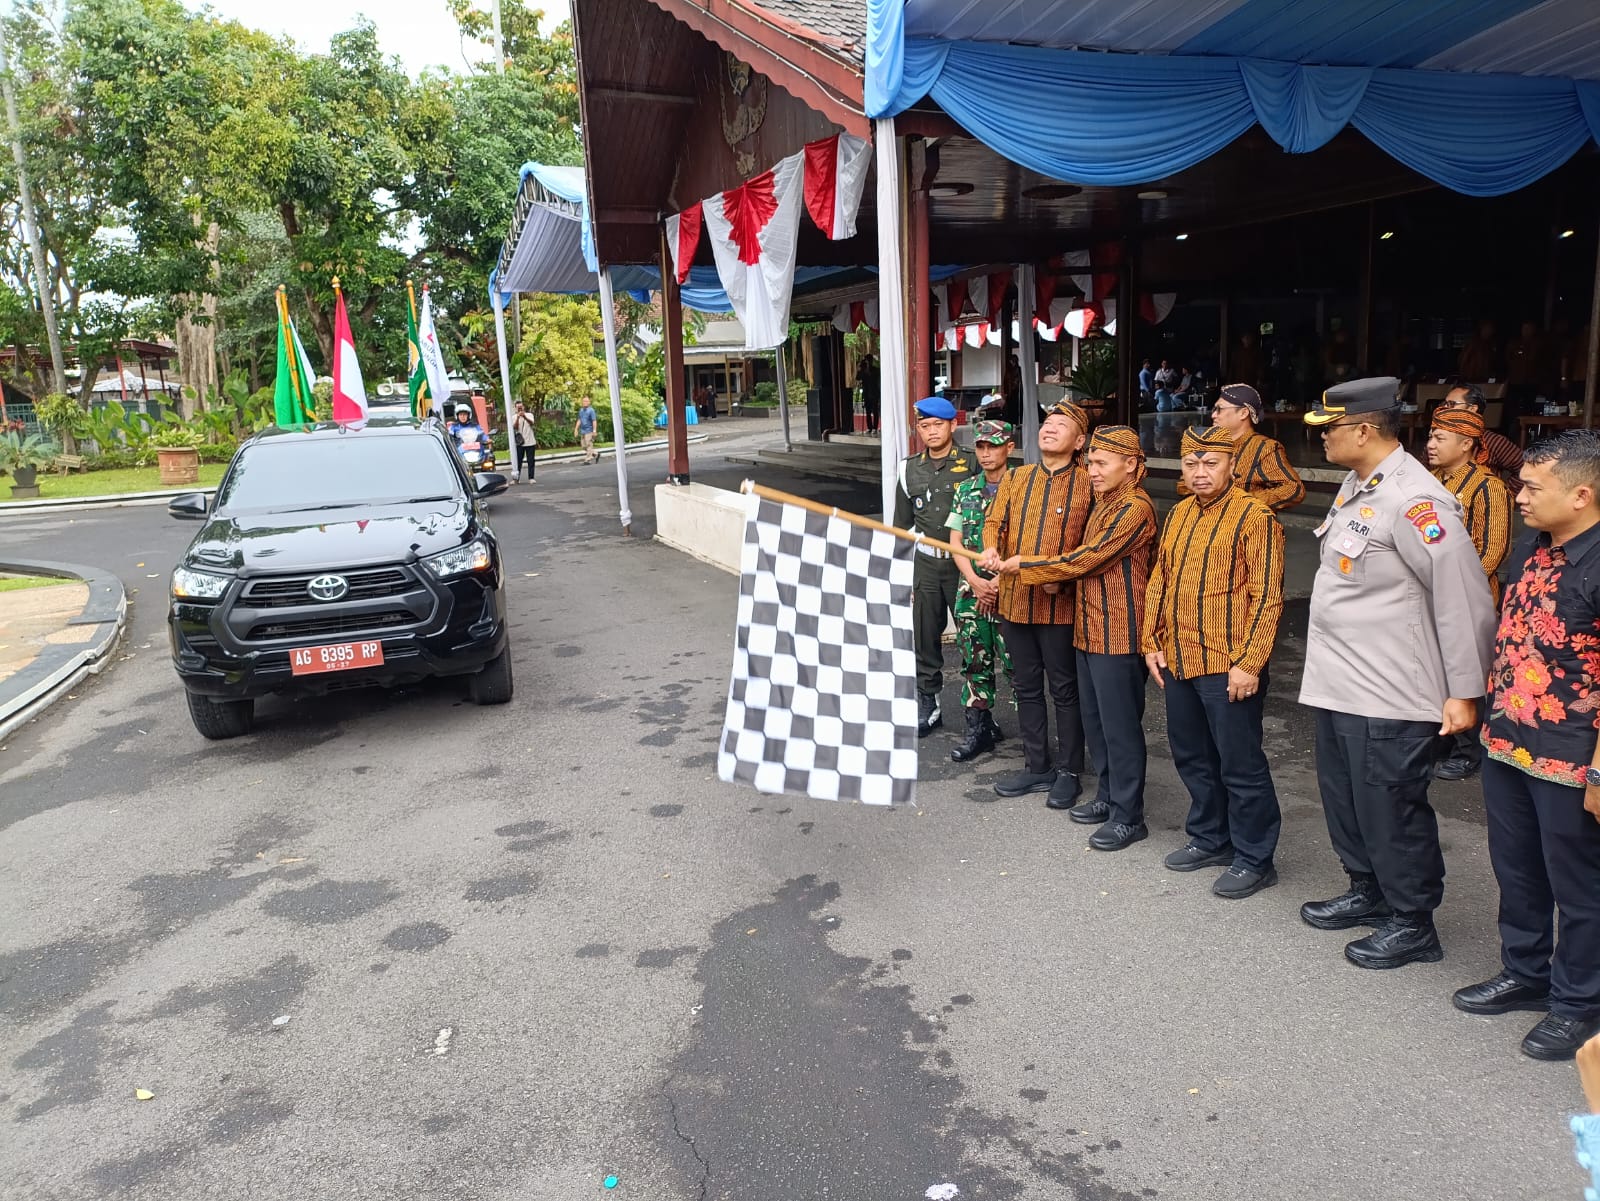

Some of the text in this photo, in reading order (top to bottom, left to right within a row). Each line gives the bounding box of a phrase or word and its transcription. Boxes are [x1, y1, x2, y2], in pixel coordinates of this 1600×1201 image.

[1347, 519, 1370, 536] POLRI
[295, 642, 378, 666] AG 8395 RP
